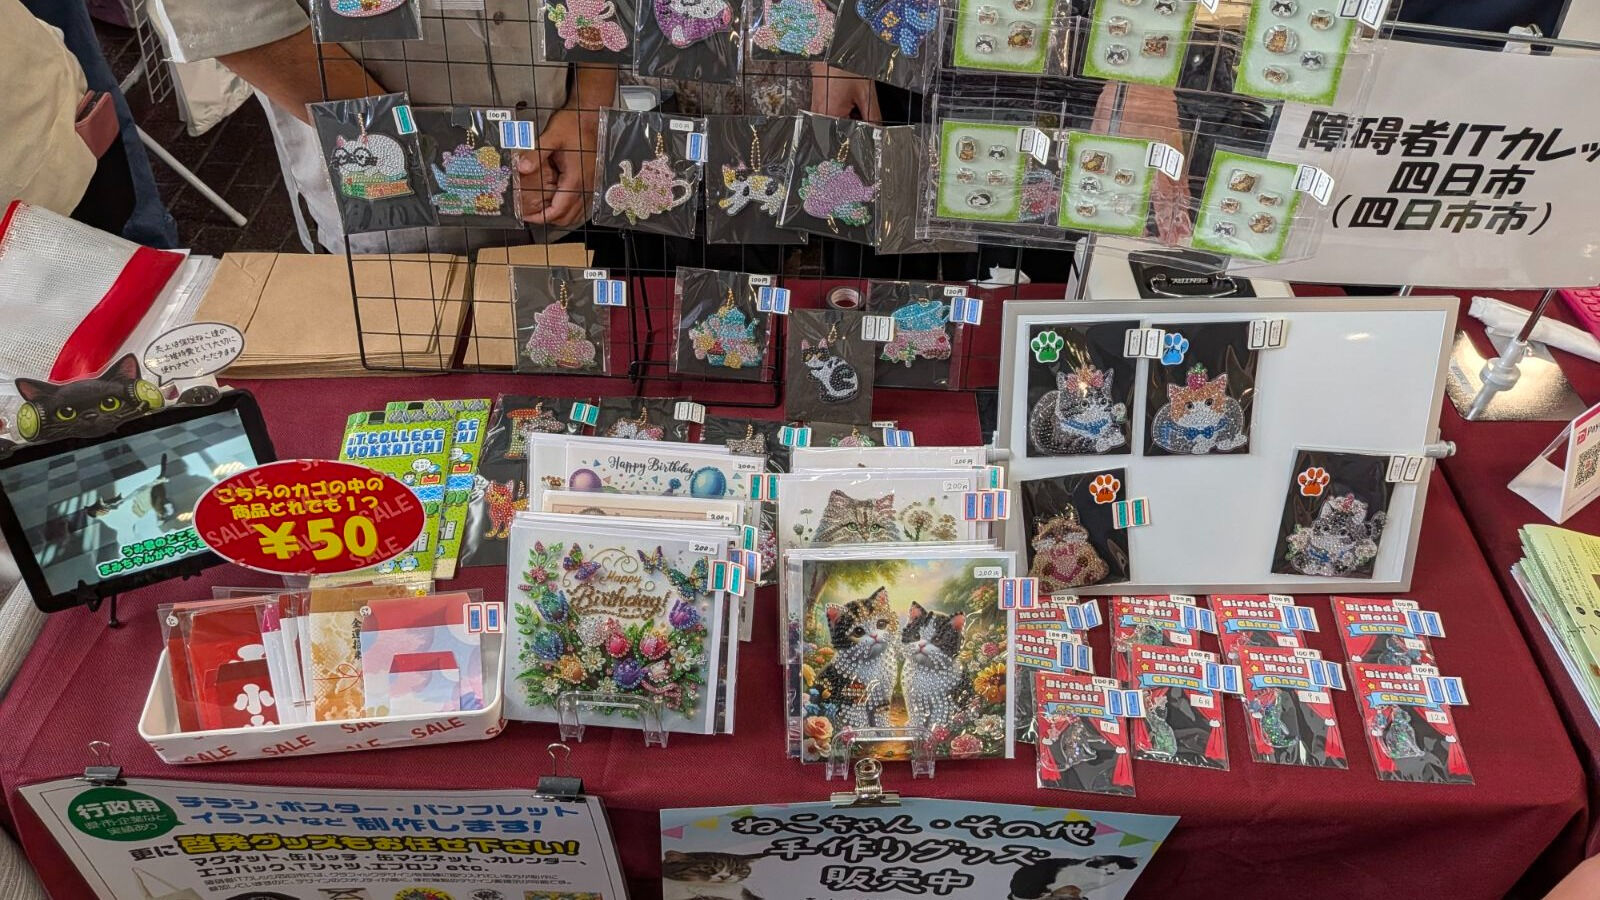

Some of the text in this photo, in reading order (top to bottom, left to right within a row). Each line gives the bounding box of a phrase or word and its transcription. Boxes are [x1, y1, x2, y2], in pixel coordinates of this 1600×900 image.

[1387, 161, 1536, 199] 四日市
[1332, 194, 1552, 235] （四日市市）
[346, 441, 444, 459] YOKKAICHI
[608, 456, 695, 482] Happy Birthday
[217, 477, 384, 503] こちらのカゴの中の
[252, 515, 379, 562] ¥50
[601, 570, 642, 588] Happy
[1122, 596, 1181, 609] Birthda
[1222, 600, 1281, 610] Birthda
[1345, 603, 1405, 613] Birthda
[1141, 650, 1201, 664] Birthda
[1249, 652, 1306, 665] Birthda
[1045, 679, 1102, 692] Birthda
[1364, 669, 1422, 681] Birthda
[411, 716, 466, 739] SALE
[262, 734, 316, 757] SALE
[76, 798, 161, 820] 行政用
[176, 795, 579, 818] チラシ・ポスター・パンフレット
[731, 813, 1095, 846] ねこちゃん・その他
[764, 836, 1051, 865] 手作りグッズ
[821, 865, 975, 895] 販売中
